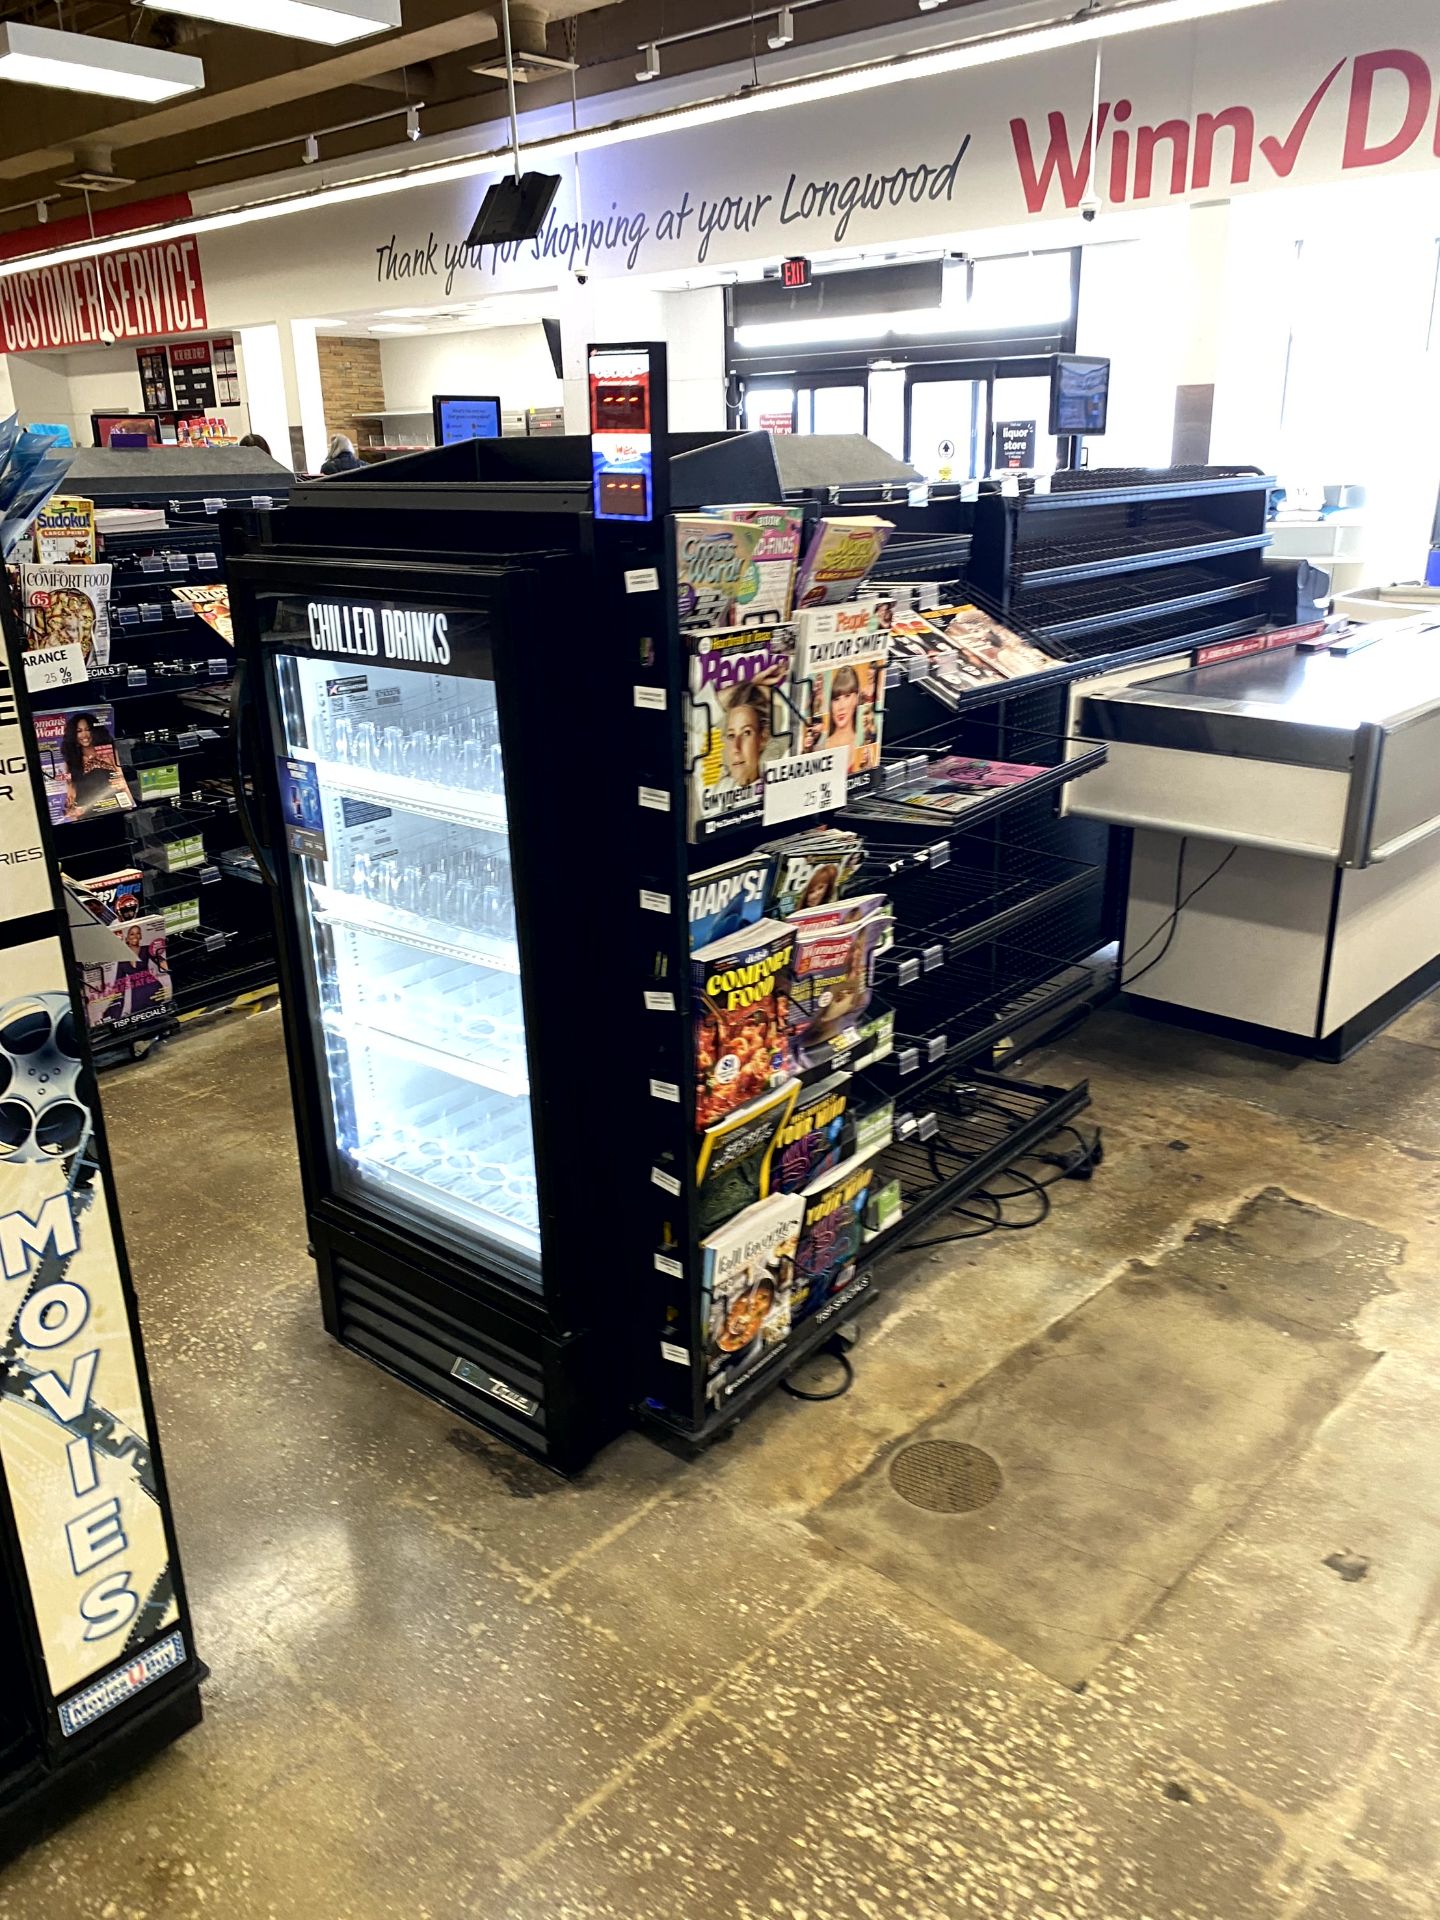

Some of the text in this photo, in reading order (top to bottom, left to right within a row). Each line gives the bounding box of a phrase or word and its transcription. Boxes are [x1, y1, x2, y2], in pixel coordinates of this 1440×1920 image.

[1009, 48, 1440, 214] Winn D
[376, 232, 438, 282] Thank
[444, 238, 482, 295] you
[531, 201, 650, 271] shopping
[656, 192, 694, 240] at
[698, 194, 772, 264] your
[780, 134, 971, 242] Longwood
[784, 261, 805, 286] EXIT
[0, 241, 204, 351] CUSTOMER SERVICE
[1003, 427, 1028, 440] liquor
[1003, 440, 1027, 450] store
[37, 512, 91, 530] Sudoku!
[27, 572, 110, 588] COMFORT FOOD
[31, 593, 50, 605] 65
[307, 602, 451, 666] CHILLED DRINKS
[22, 649, 68, 666] ARANCE
[809, 631, 889, 664] TAYLOR SWIFT
[44, 672, 58, 684] 25
[61, 677, 73, 685] OFF
[35, 726, 65, 738] World
[766, 754, 834, 785] CLEARANCE
[688, 868, 768, 923] HARKS!
[131, 1005, 167, 1023] SPECIALS
[0, 1189, 139, 1642] MOVIES
[128, 1662, 145, 1686] U
